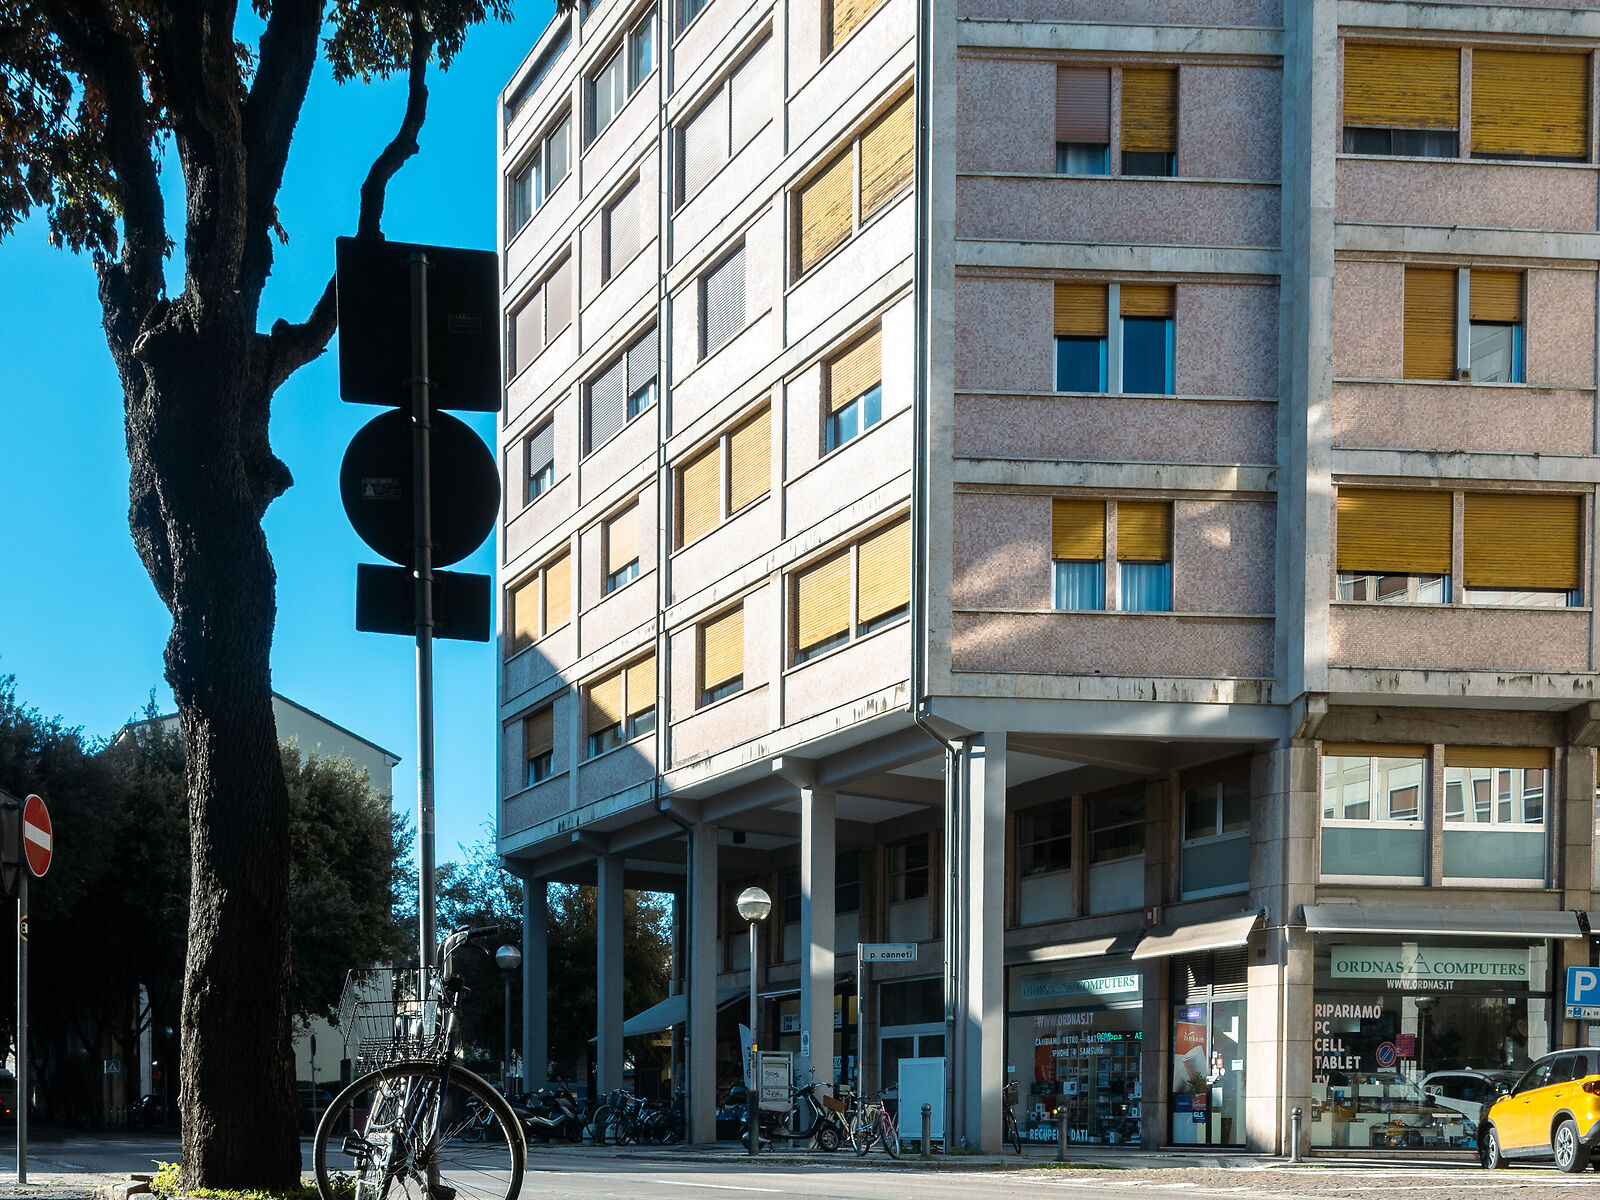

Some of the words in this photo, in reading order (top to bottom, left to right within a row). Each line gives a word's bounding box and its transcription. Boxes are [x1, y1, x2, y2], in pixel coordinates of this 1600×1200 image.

[1336, 960, 1404, 974] ORDNAS
[1433, 961, 1526, 976] COMPUTERS
[1077, 976, 1135, 992] COMPUTERS
[1387, 979, 1454, 991] WWW.ORDNAS.IT
[1574, 971, 1597, 1001] P
[1314, 1003, 1382, 1019] RIPARIAMO
[1037, 1012, 1094, 1027] WWW.ORDNAS.IT
[1314, 1020, 1330, 1035] PC
[1063, 1035, 1079, 1044] VETRO
[1314, 1038, 1345, 1052] CELL
[1314, 1056, 1361, 1070] TABLET
[1314, 1075, 1330, 1087] TV
[1071, 1128, 1088, 1141] DATI
